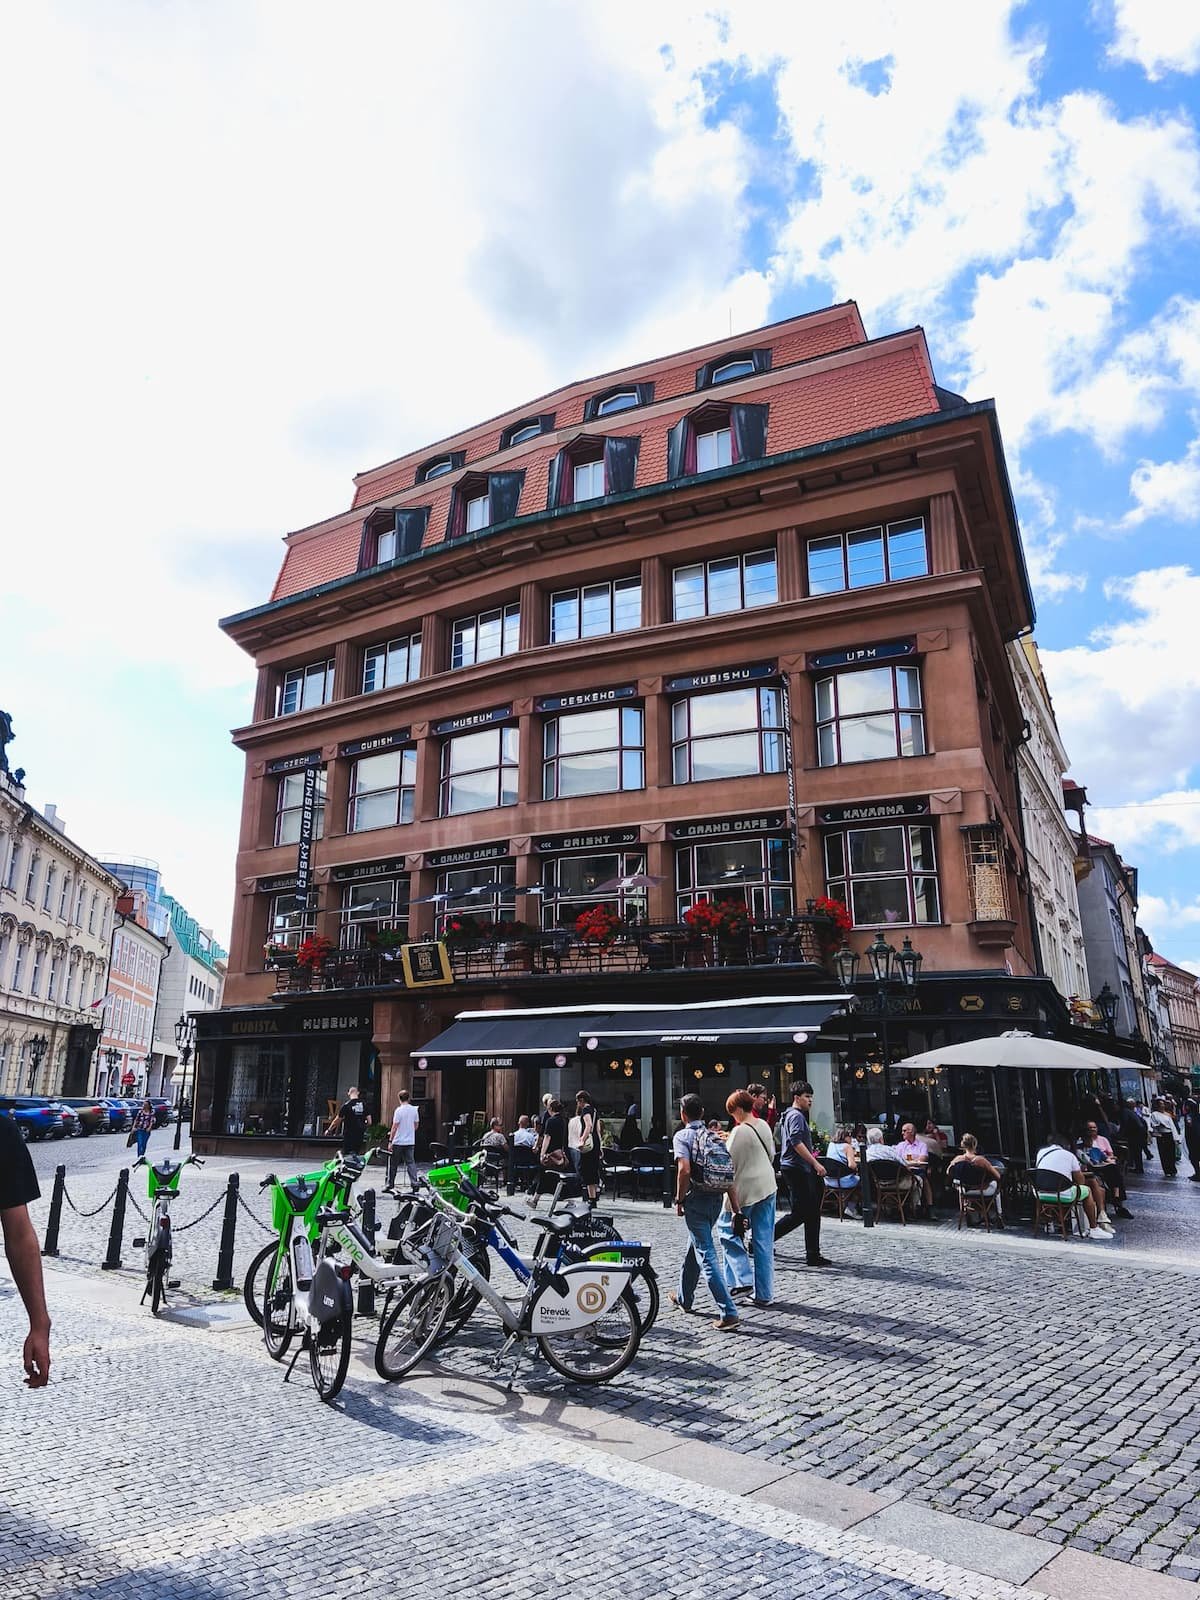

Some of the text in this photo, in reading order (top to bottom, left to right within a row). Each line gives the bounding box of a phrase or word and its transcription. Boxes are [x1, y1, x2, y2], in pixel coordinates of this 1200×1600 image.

[846, 648, 876, 661] UPM
[692, 669, 750, 686] KUBISMU
[452, 712, 493, 728] MUSEUM
[360, 736, 393, 750] CUBISM
[283, 756, 310, 769] CZECH
[297, 768, 315, 888] ČESKÝ KUBISMUS
[687, 822, 730, 835] GRAND
[563, 835, 611, 848] ORIENT
[440, 851, 471, 864] GRAND
[353, 864, 387, 876] ORIENT
[303, 1016, 359, 1030] MUSEUM
[585, 1291, 599, 1306] D
[540, 1305, 571, 1316] Dřevák
